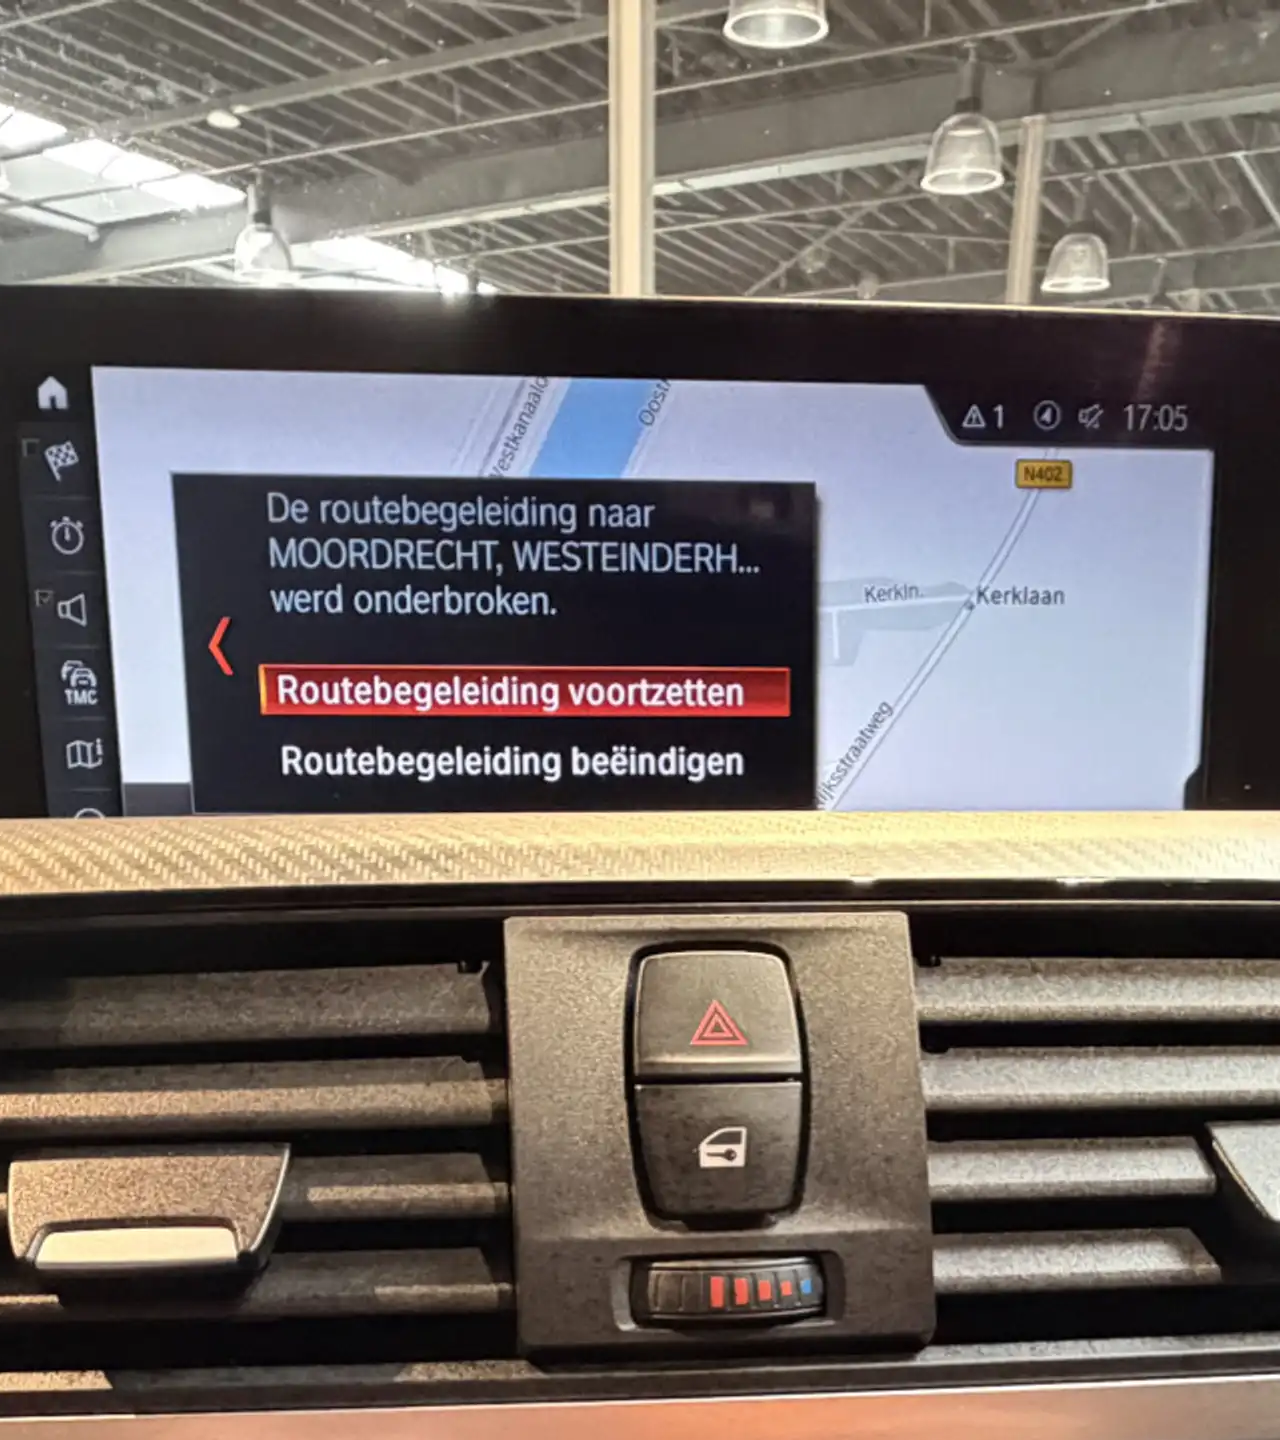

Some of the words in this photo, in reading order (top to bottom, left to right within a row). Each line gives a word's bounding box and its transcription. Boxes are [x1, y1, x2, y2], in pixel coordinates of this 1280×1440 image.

[993, 404, 1004, 429] 1
[1123, 404, 1188, 432] 17:05
[1023, 465, 1063, 482] N402
[267, 491, 309, 524] De
[320, 494, 577, 534] routebegeleiding
[588, 503, 656, 528] naar
[268, 537, 503, 576] MOORDRECHT,
[512, 540, 760, 574] WESTEINDERH...
[270, 583, 343, 614] werd
[354, 584, 557, 616] onderbroken.
[976, 586, 1065, 606] Kerklaan
[64, 689, 98, 706] TMC
[277, 674, 559, 713] Routebegeleiding
[568, 678, 744, 707] voortzetten
[281, 745, 562, 783] Routebegeleiding
[571, 745, 744, 783] beëindigen
